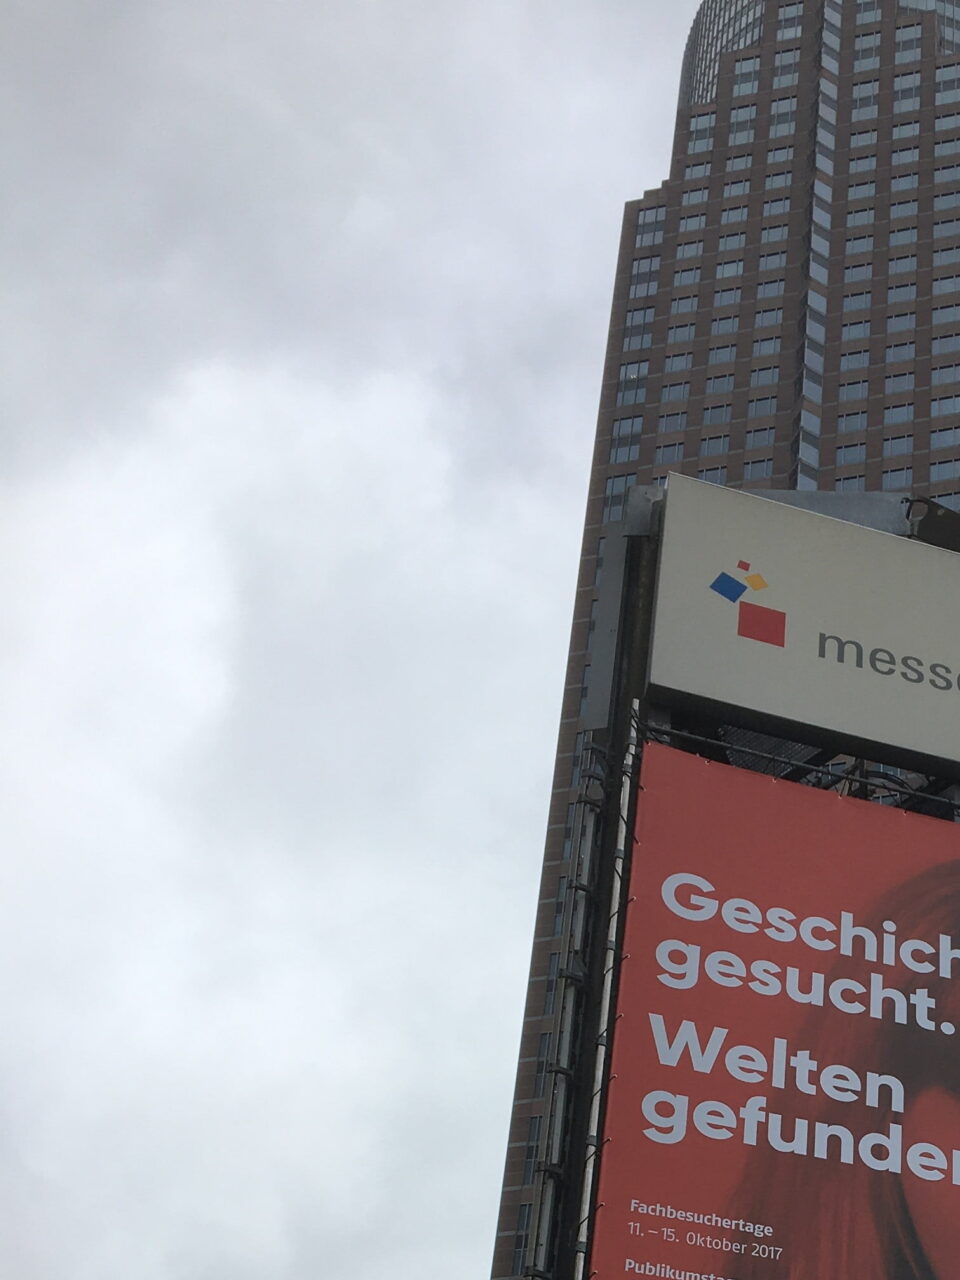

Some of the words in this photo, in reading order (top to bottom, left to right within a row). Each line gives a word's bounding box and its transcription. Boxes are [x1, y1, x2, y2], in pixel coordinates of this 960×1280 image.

[655, 938, 956, 1036] gesucht.
[648, 1012, 905, 1114] Welten
[630, 1199, 774, 1238] Fachbesuchertage
[686, 1231, 748, 1254] Oktober
[751, 1243, 783, 1260] 2017
